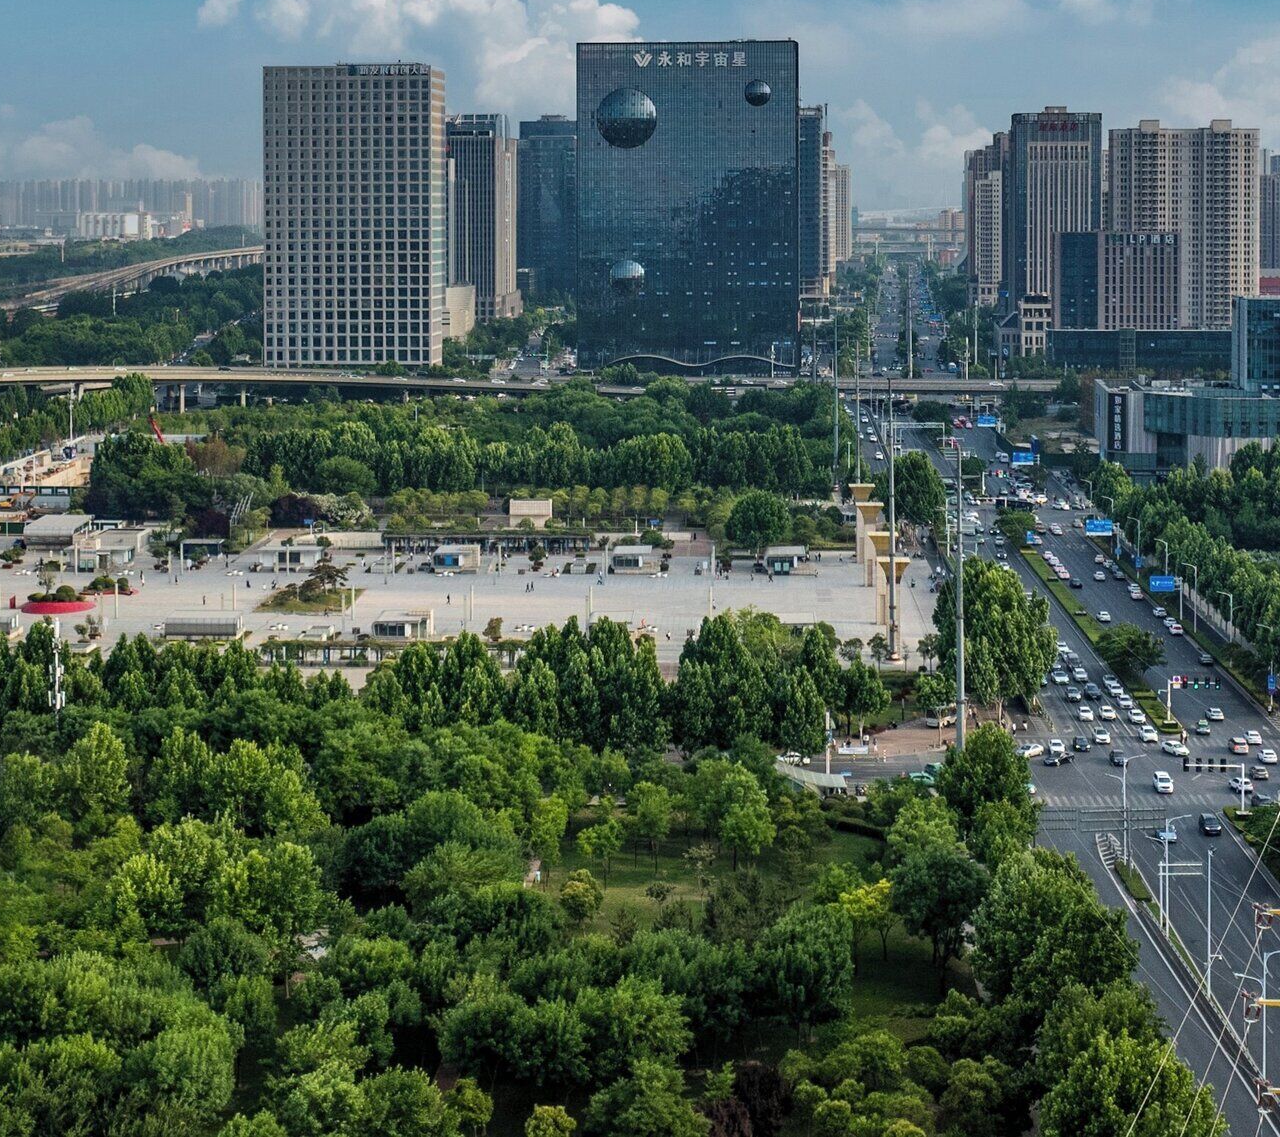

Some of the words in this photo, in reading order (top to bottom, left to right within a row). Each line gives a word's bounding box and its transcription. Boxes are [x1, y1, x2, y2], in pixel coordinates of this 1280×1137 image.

[658, 51, 748, 68] 永和宇宙星
